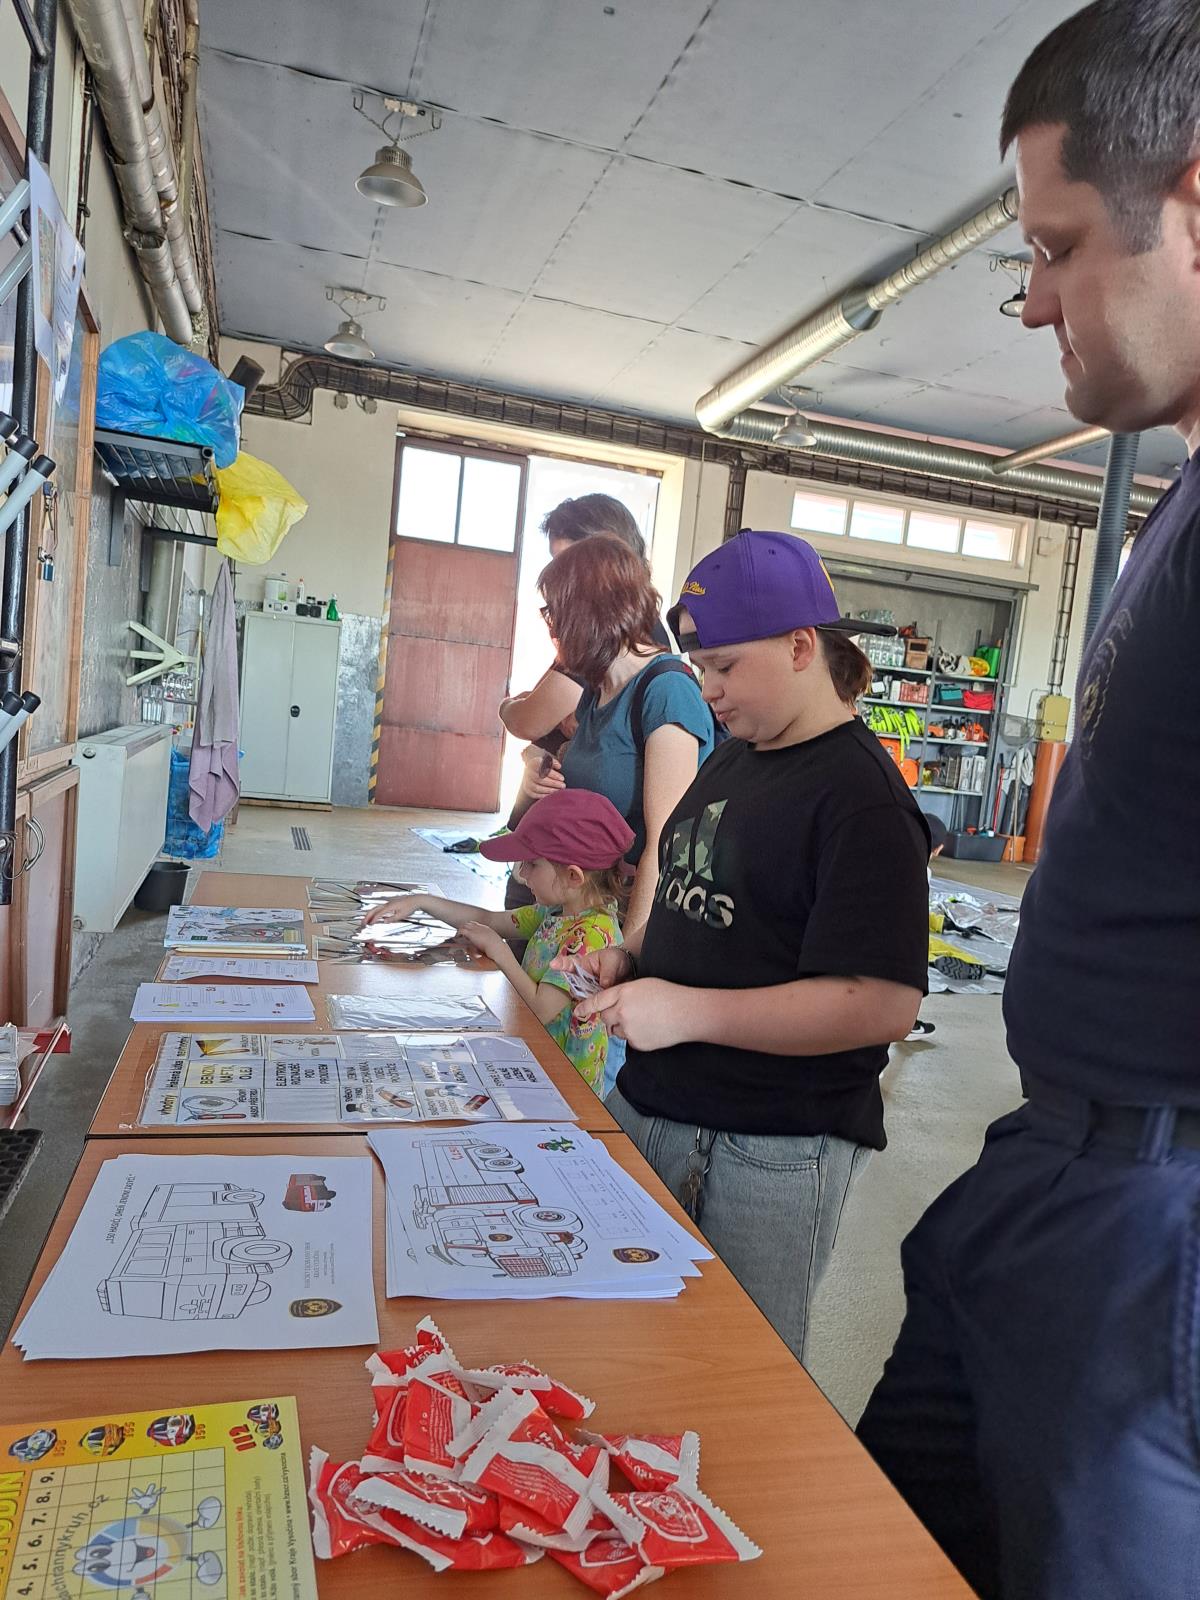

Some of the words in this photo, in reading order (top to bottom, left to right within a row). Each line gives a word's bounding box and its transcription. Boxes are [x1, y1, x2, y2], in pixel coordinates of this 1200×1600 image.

[200, 1064, 218, 1084] BENZIN,
[220, 1065, 236, 1083] NAFTA,
[239, 1067, 252, 1080] OLEJ
[275, 1062, 287, 1086] ELEKTRICKÝ
[305, 1070, 315, 1078] POD
[318, 1063, 330, 1084] PROUDEM
[157, 1094, 178, 1115] vhodný
[228, 1424, 258, 1452] 112
[41, 1471, 55, 1484] 9.
[36, 1491, 51, 1504] 8.
[31, 1512, 47, 1526] 7.
[286, 1518, 296, 1546] Vysočina
[28, 1534, 43, 1548] 6.
[288, 1548, 297, 1564] Kraje
[22, 1557, 38, 1571] 5.
[17, 1581, 34, 1596] 4.
